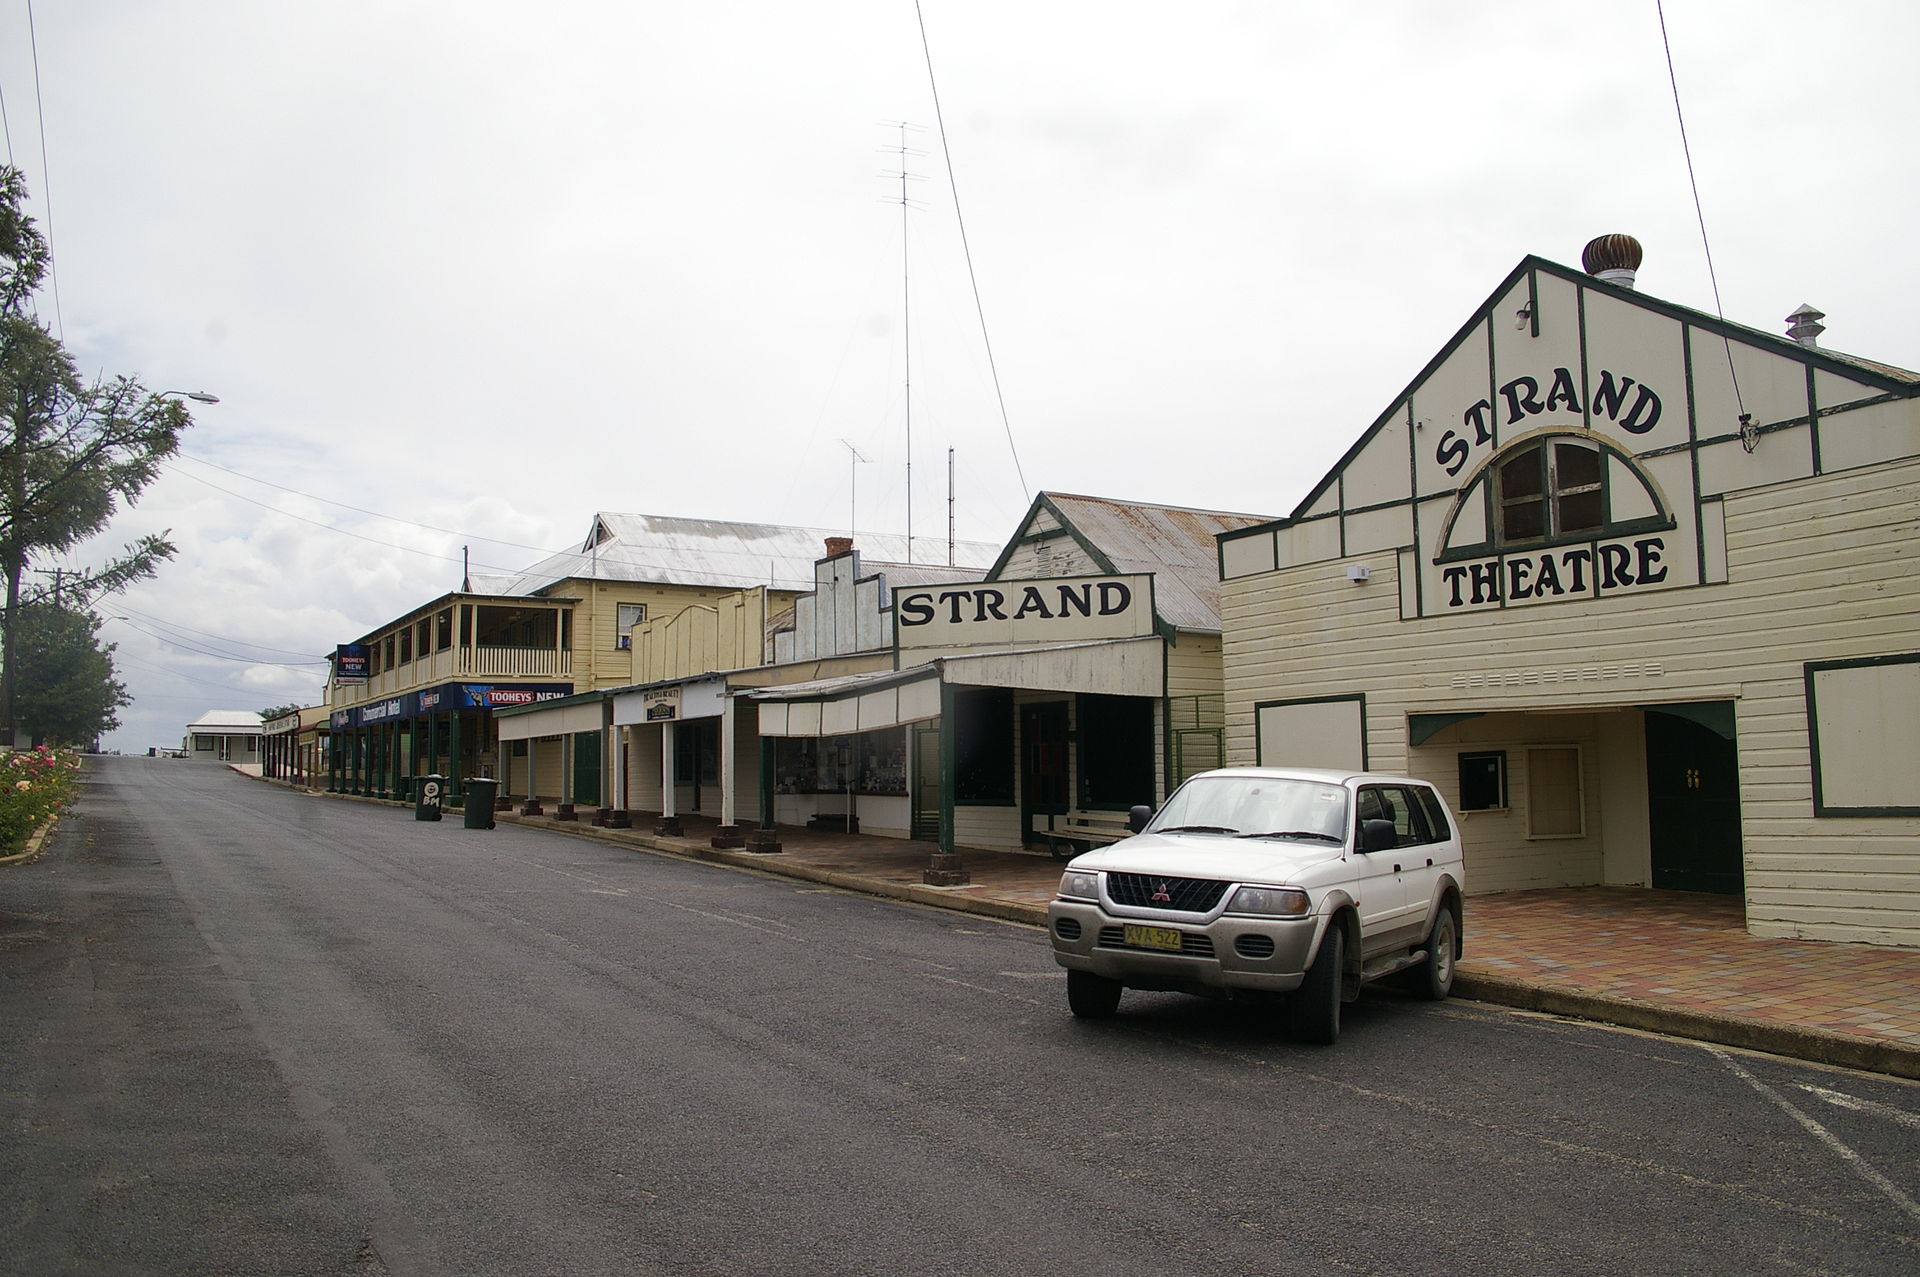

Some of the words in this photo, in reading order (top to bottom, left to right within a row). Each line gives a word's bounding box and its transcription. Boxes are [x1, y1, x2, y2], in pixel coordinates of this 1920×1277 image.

[1436, 367, 1662, 477] STRAND
[1443, 537, 1668, 607] THEATRE
[900, 581, 1131, 626] STRAND
[490, 692, 532, 702] TOOHEYS
